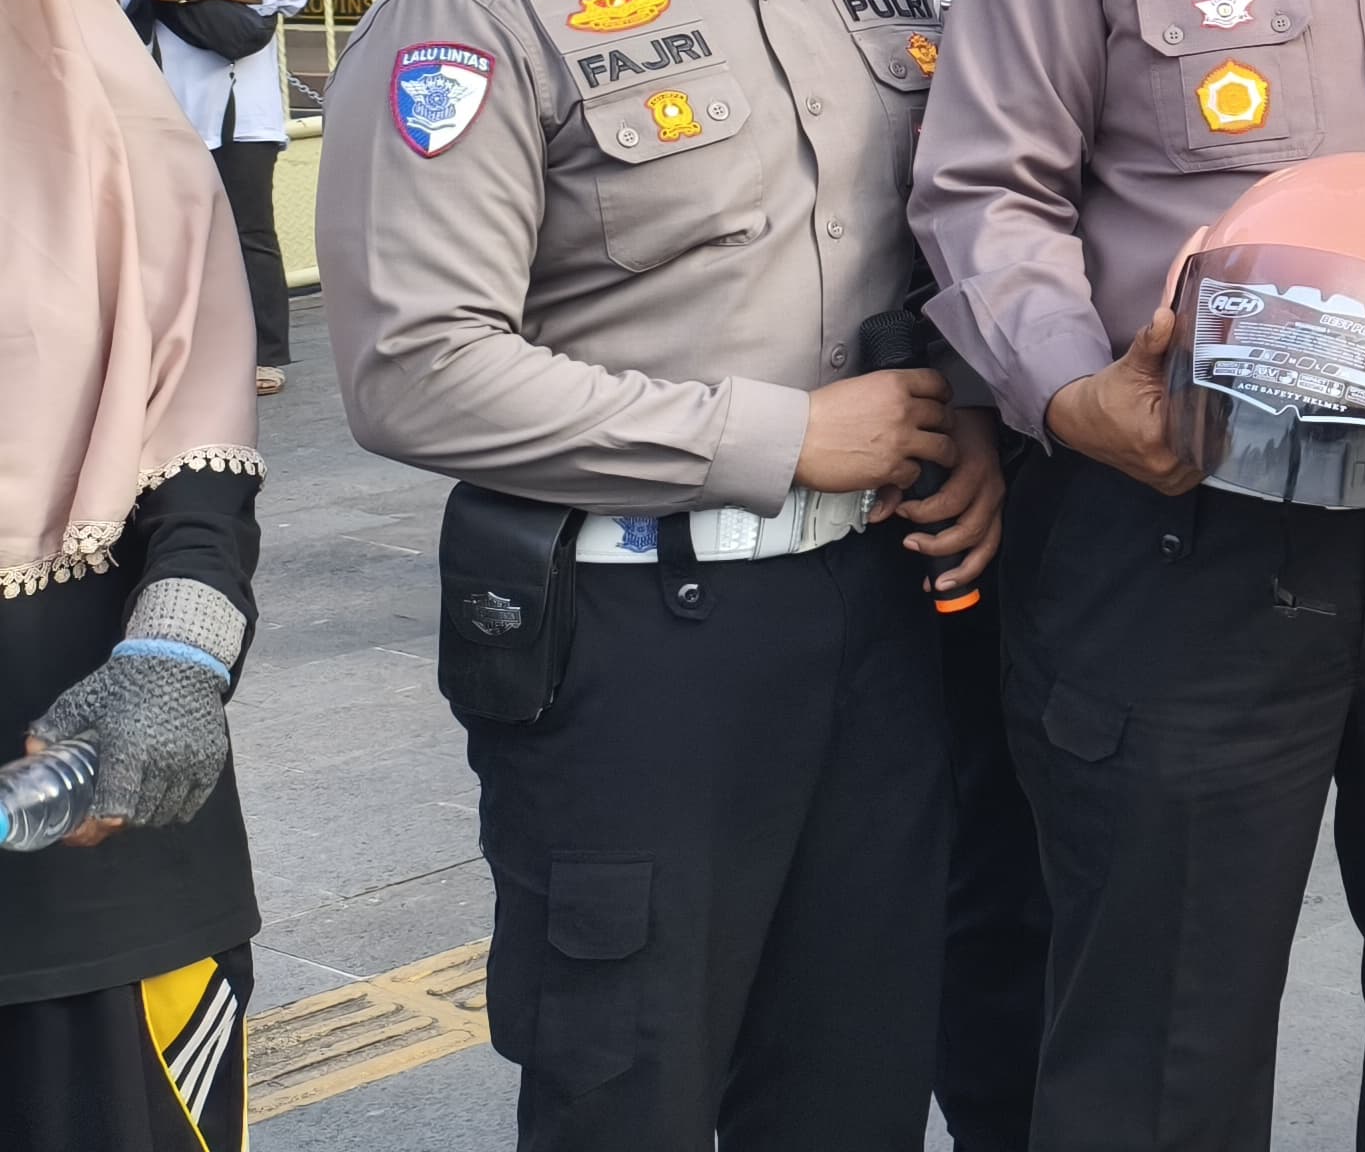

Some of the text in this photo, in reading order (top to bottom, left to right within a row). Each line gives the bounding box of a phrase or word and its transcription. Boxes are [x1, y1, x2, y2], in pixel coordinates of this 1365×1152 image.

[403, 47, 490, 71] LALU LINTAS
[578, 30, 713, 90] FAJRI
[1212, 295, 1254, 312] ACH
[1320, 314, 1353, 331] BEST
[1238, 382, 1258, 392] ACH
[1260, 386, 1300, 401] SAFETY
[1303, 396, 1348, 413] HELMET
